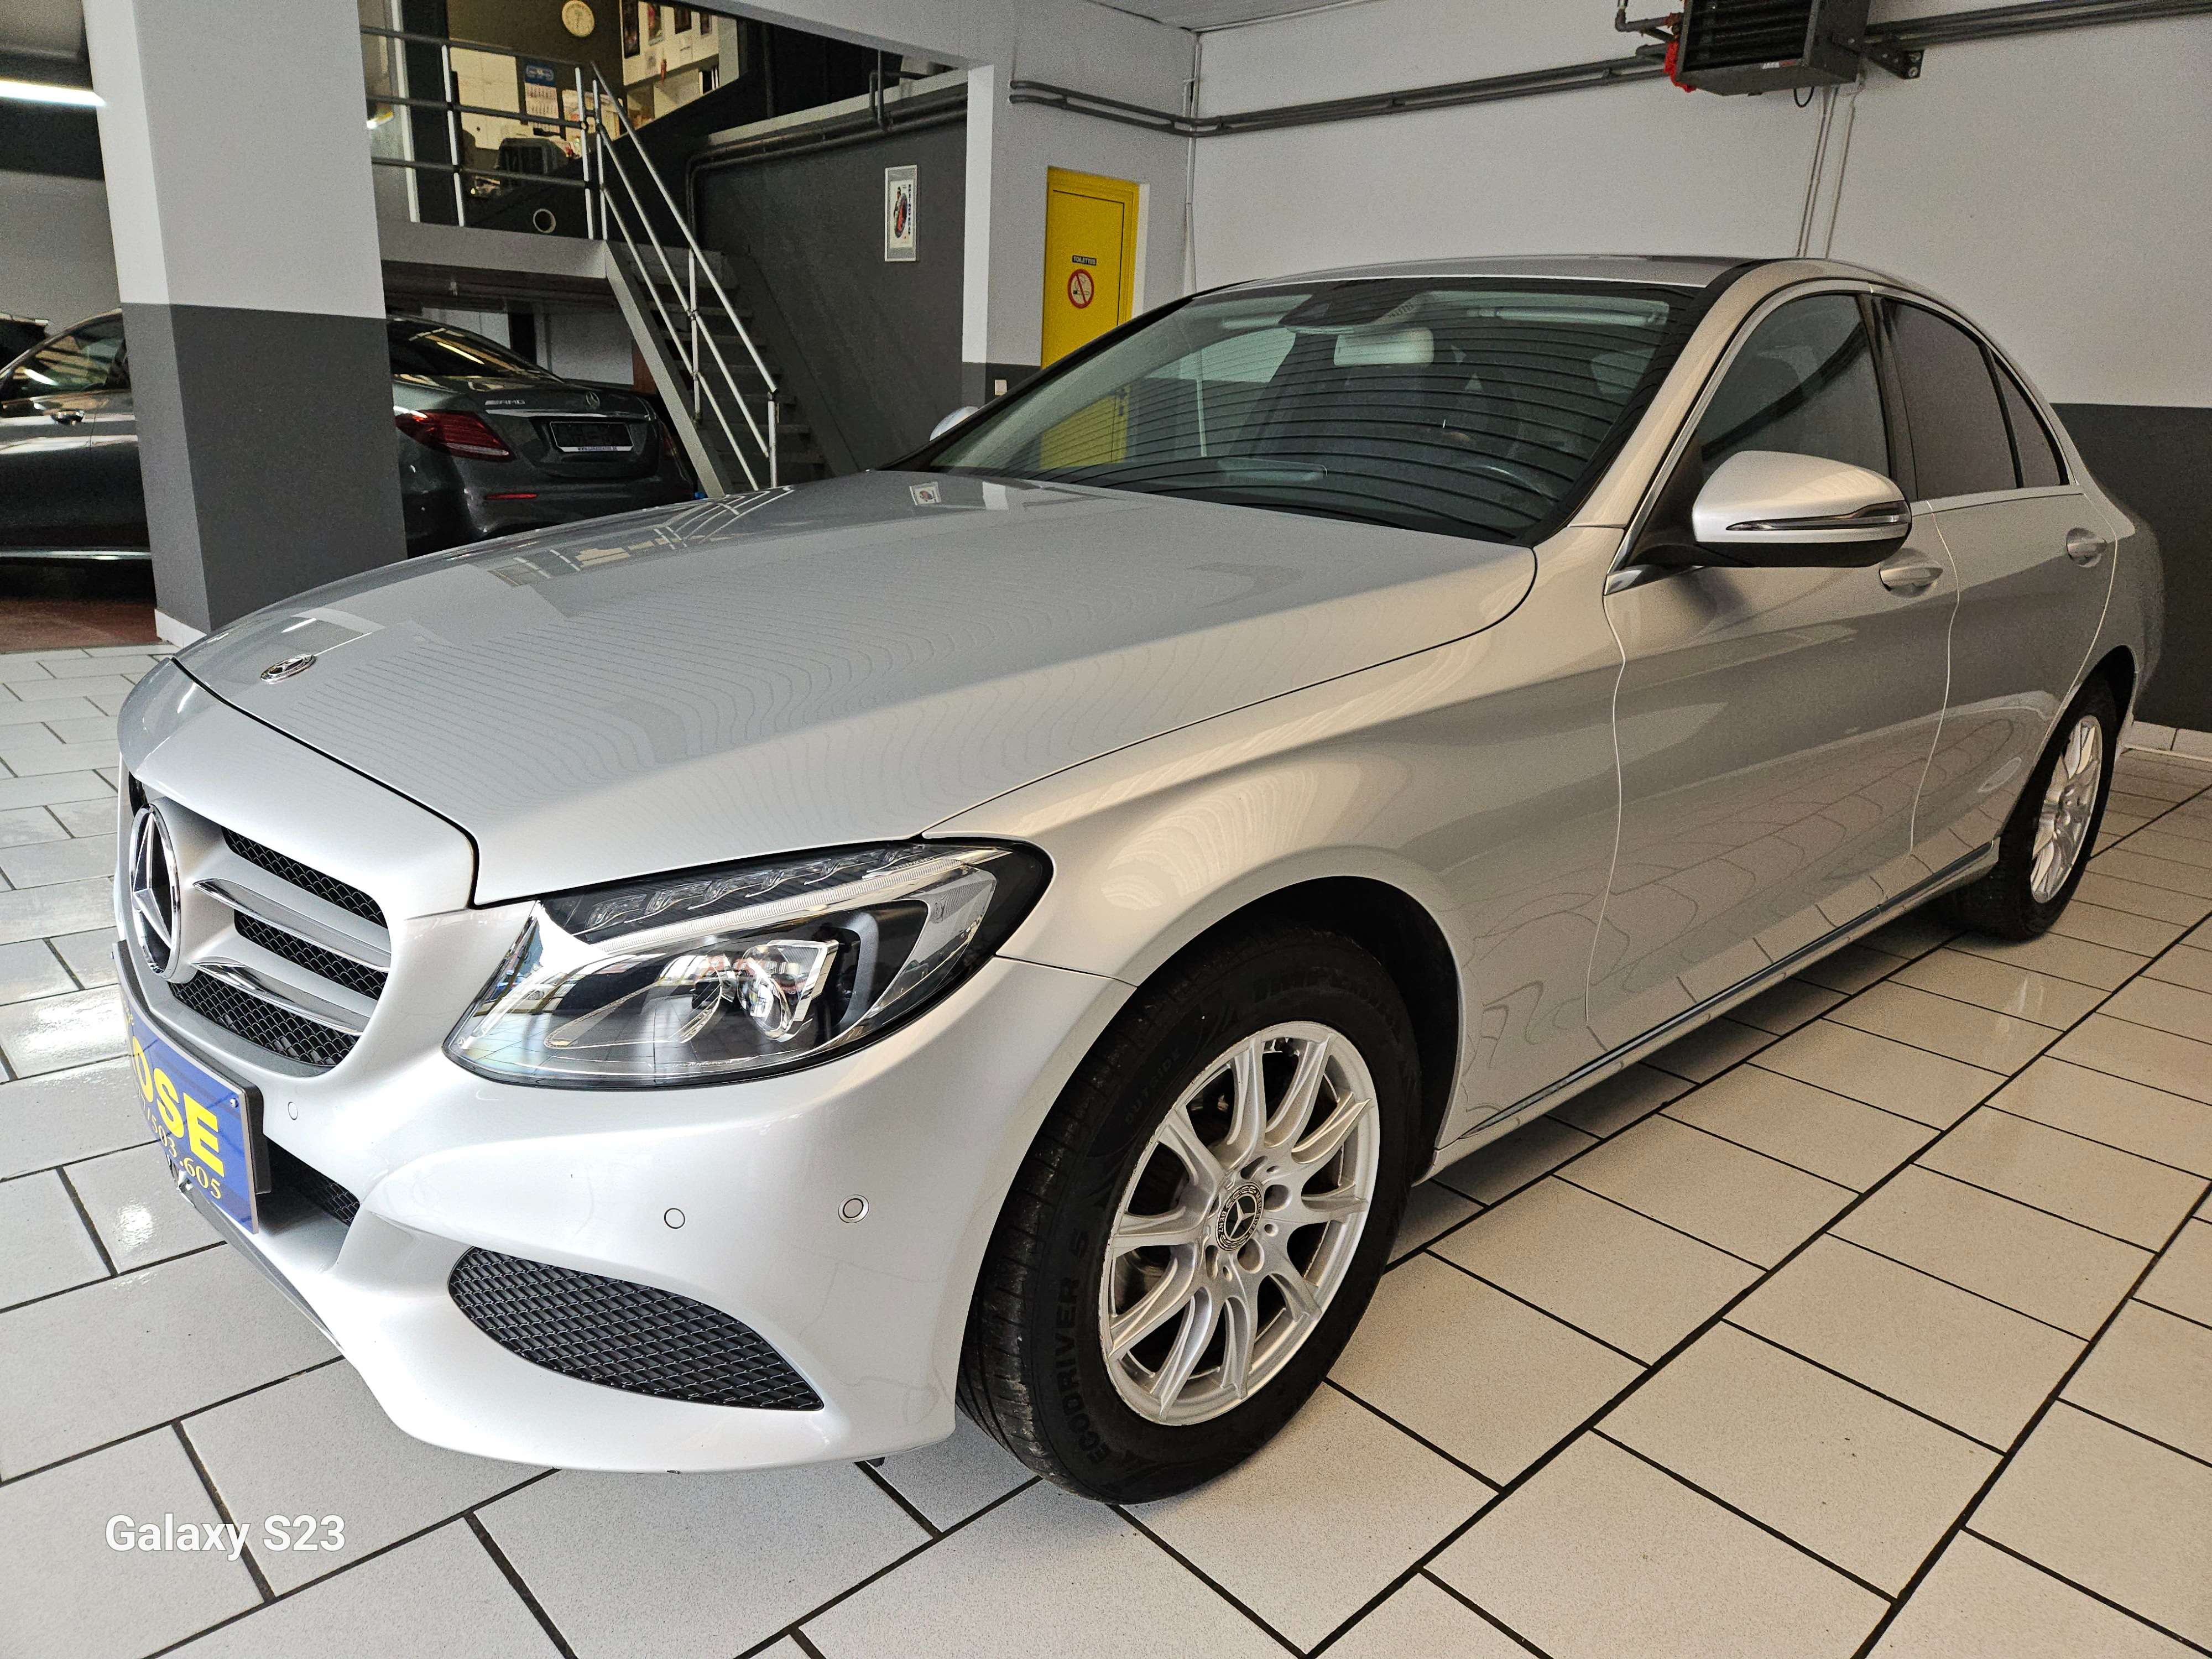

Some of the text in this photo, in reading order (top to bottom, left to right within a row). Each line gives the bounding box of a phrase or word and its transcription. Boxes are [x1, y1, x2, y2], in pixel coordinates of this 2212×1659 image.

[131, 1036, 225, 1178] OSE
[1218, 1211, 1227, 1235] BENZ
[1056, 1277, 1110, 1465] ECODRIVER
